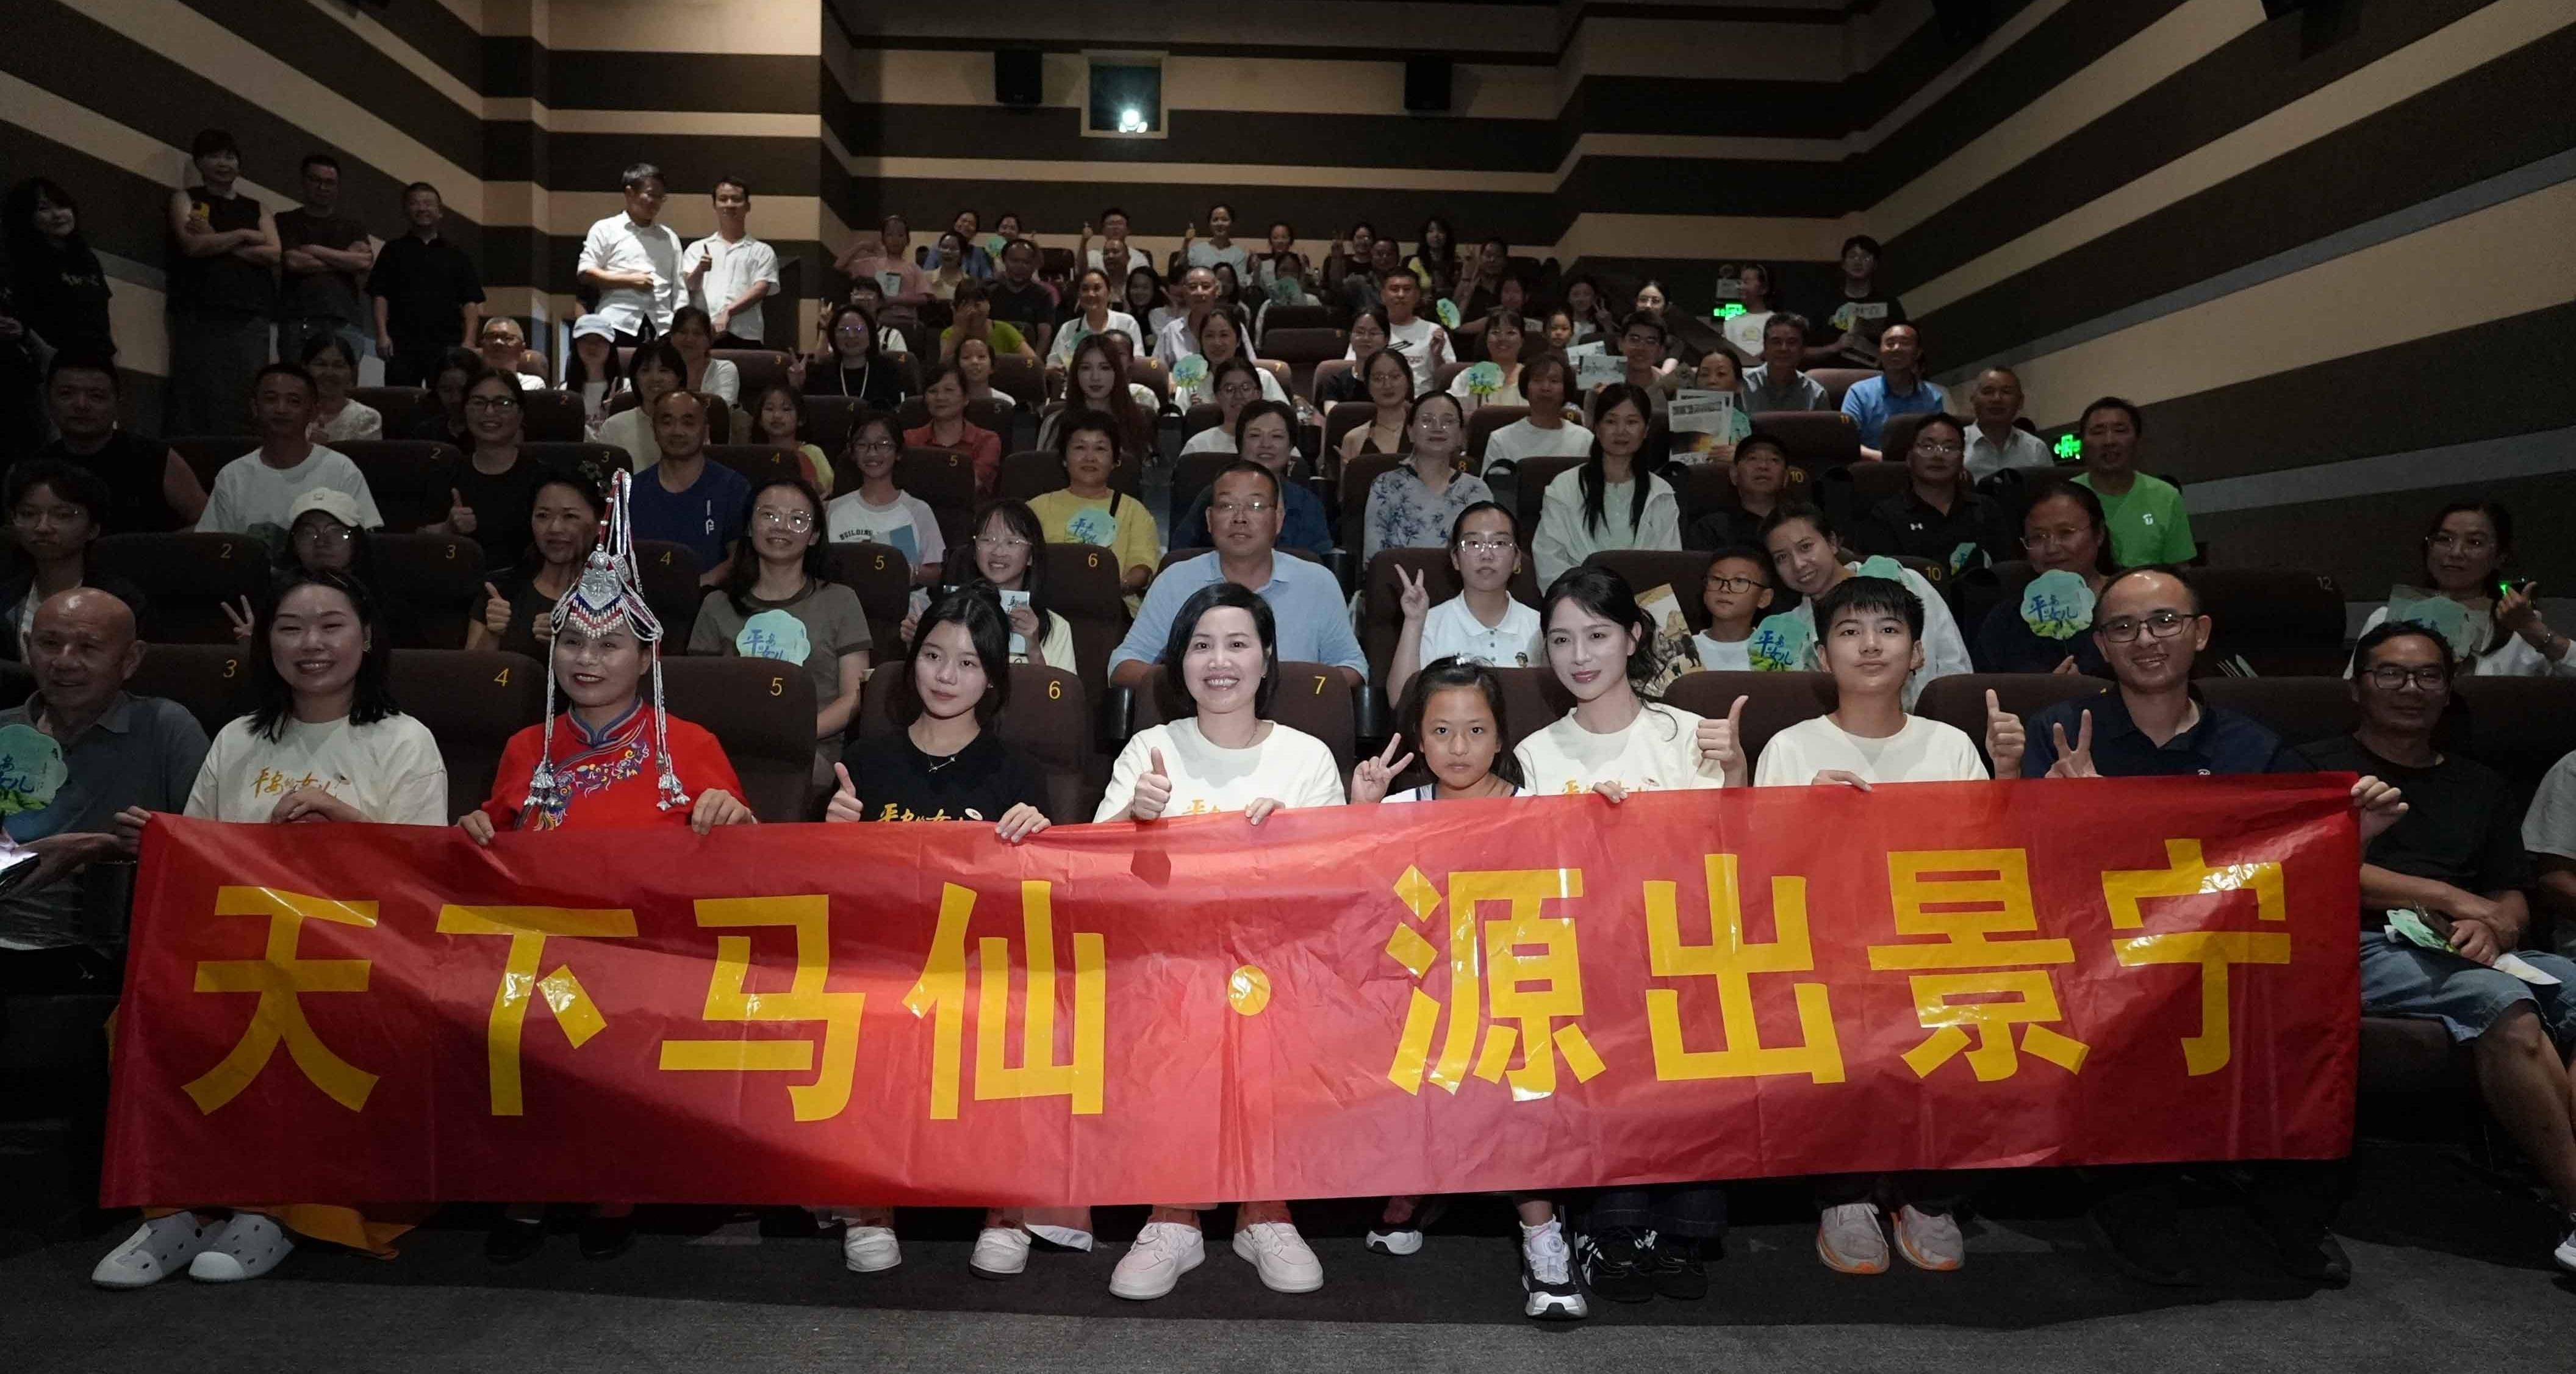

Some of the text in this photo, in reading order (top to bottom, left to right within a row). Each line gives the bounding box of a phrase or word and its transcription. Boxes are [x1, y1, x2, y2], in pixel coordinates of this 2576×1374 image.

[1275, 363, 1281, 372] 7
[429, 448, 441, 459] 2
[600, 450, 609, 463] 3
[770, 451, 781, 464] 4
[949, 454, 958, 467] 5
[1458, 460, 1466, 470] 8
[1790, 470, 1803, 483] 10
[220, 543, 232, 559] 2
[445, 544, 456, 559] 3
[659, 550, 670, 566] 4
[874, 555, 884, 570] 5
[1086, 553, 1097, 567] 6
[1926, 566, 1940, 582] 10
[2316, 576, 2332, 591] 12
[223, 659, 237, 678] 3
[493, 667, 508, 688] 4
[770, 677, 783, 696] 5
[1049, 680, 1061, 699] 6
[1314, 676, 1327, 695] 7
